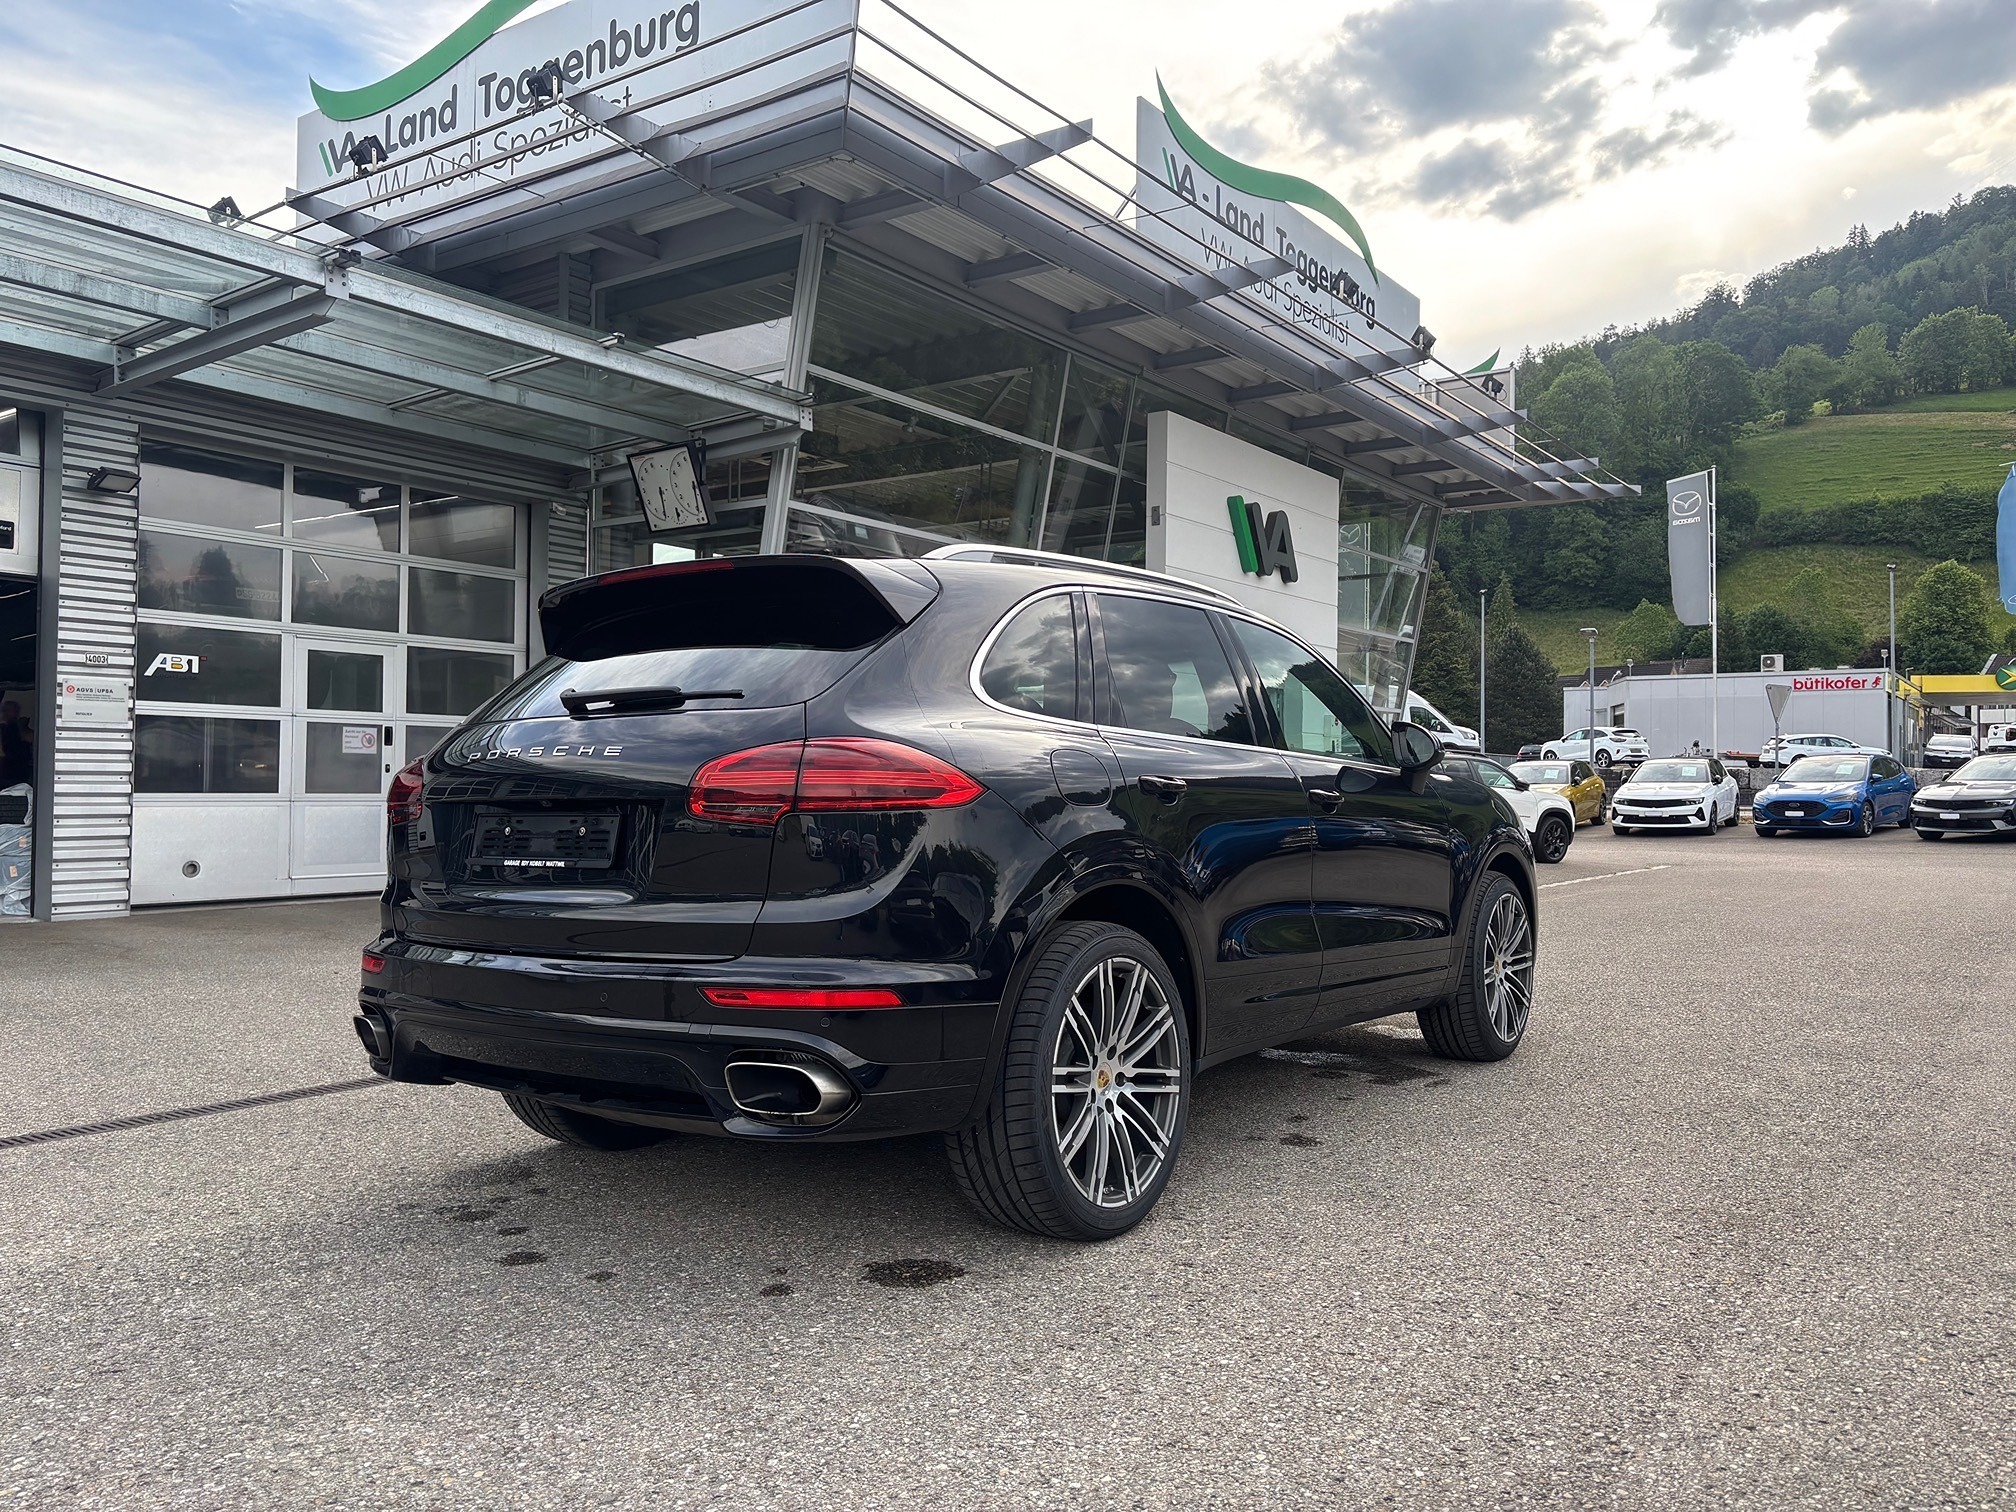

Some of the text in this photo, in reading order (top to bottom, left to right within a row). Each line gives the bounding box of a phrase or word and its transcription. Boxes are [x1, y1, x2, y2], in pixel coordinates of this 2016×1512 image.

[385, 83, 458, 155] Land
[366, 165, 408, 212] VW
[420, 139, 481, 197] Audi
[1216, 184, 1264, 246] Land
[87, 655, 106, 663] 4003
[143, 652, 200, 676] ABT
[1793, 676, 1867, 690] bütikofer
[467, 744, 624, 763] PORSCHE
